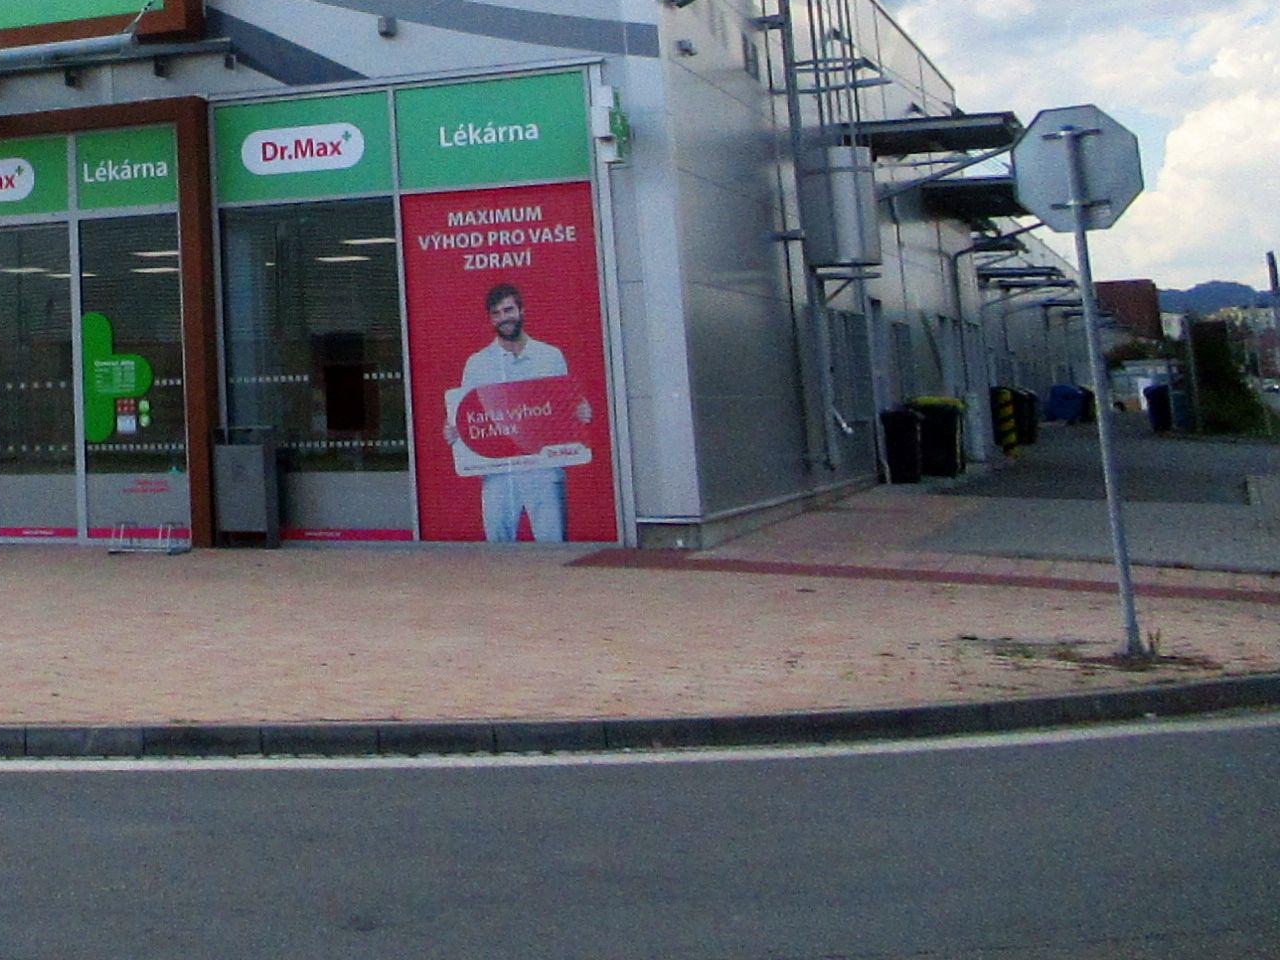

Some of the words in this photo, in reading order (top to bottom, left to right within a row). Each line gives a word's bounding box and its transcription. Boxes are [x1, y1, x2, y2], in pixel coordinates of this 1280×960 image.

[439, 120, 539, 148] Lékárna
[261, 138, 343, 163] Dr.Max
[83, 156, 169, 184] Lékárna
[447, 205, 543, 227] MAXIMUM
[418, 231, 484, 251] VÝHOD
[487, 229, 525, 247] PRO
[528, 224, 577, 244] VAŠE
[463, 248, 532, 270] ZDRAVÍ
